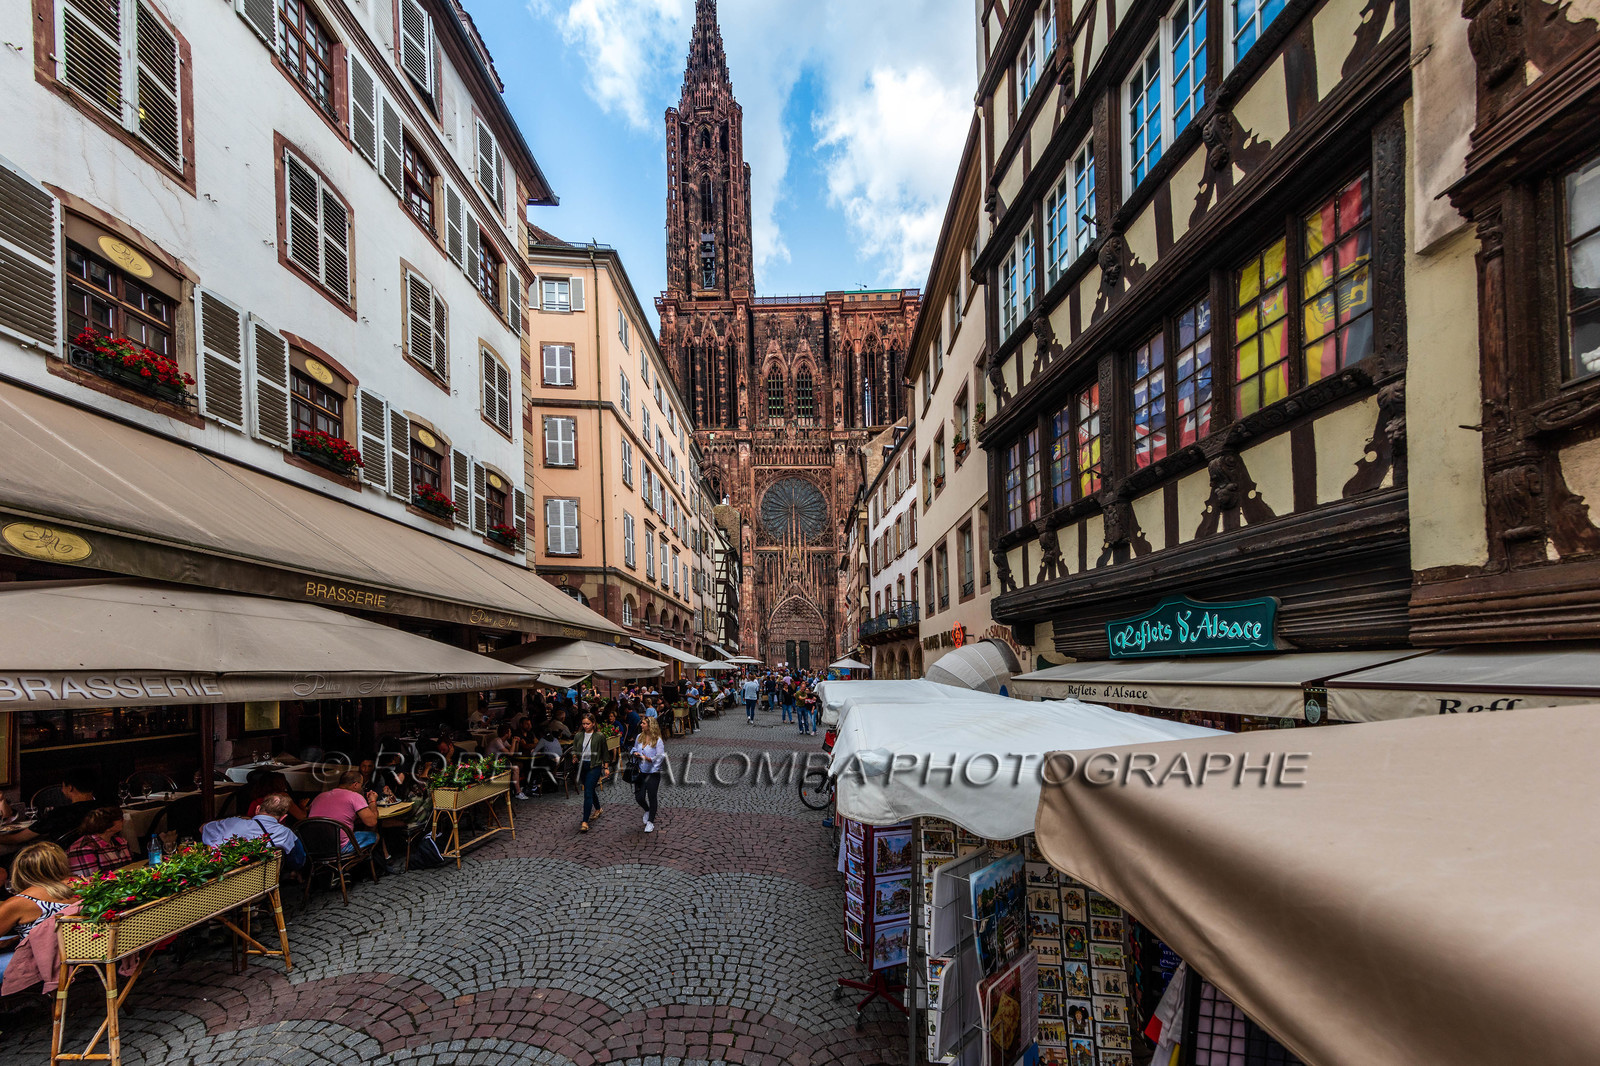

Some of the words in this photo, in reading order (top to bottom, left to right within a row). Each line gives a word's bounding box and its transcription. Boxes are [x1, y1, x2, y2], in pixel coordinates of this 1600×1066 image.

[305, 582, 386, 608] BRASSERIE
[1114, 620, 1173, 651] Reflets
[0, 675, 224, 701] BRASSERIE
[428, 675, 500, 692] RESTAURANT
[1067, 684, 1097, 697] Reflets
[1103, 685, 1148, 699] d'Alsace
